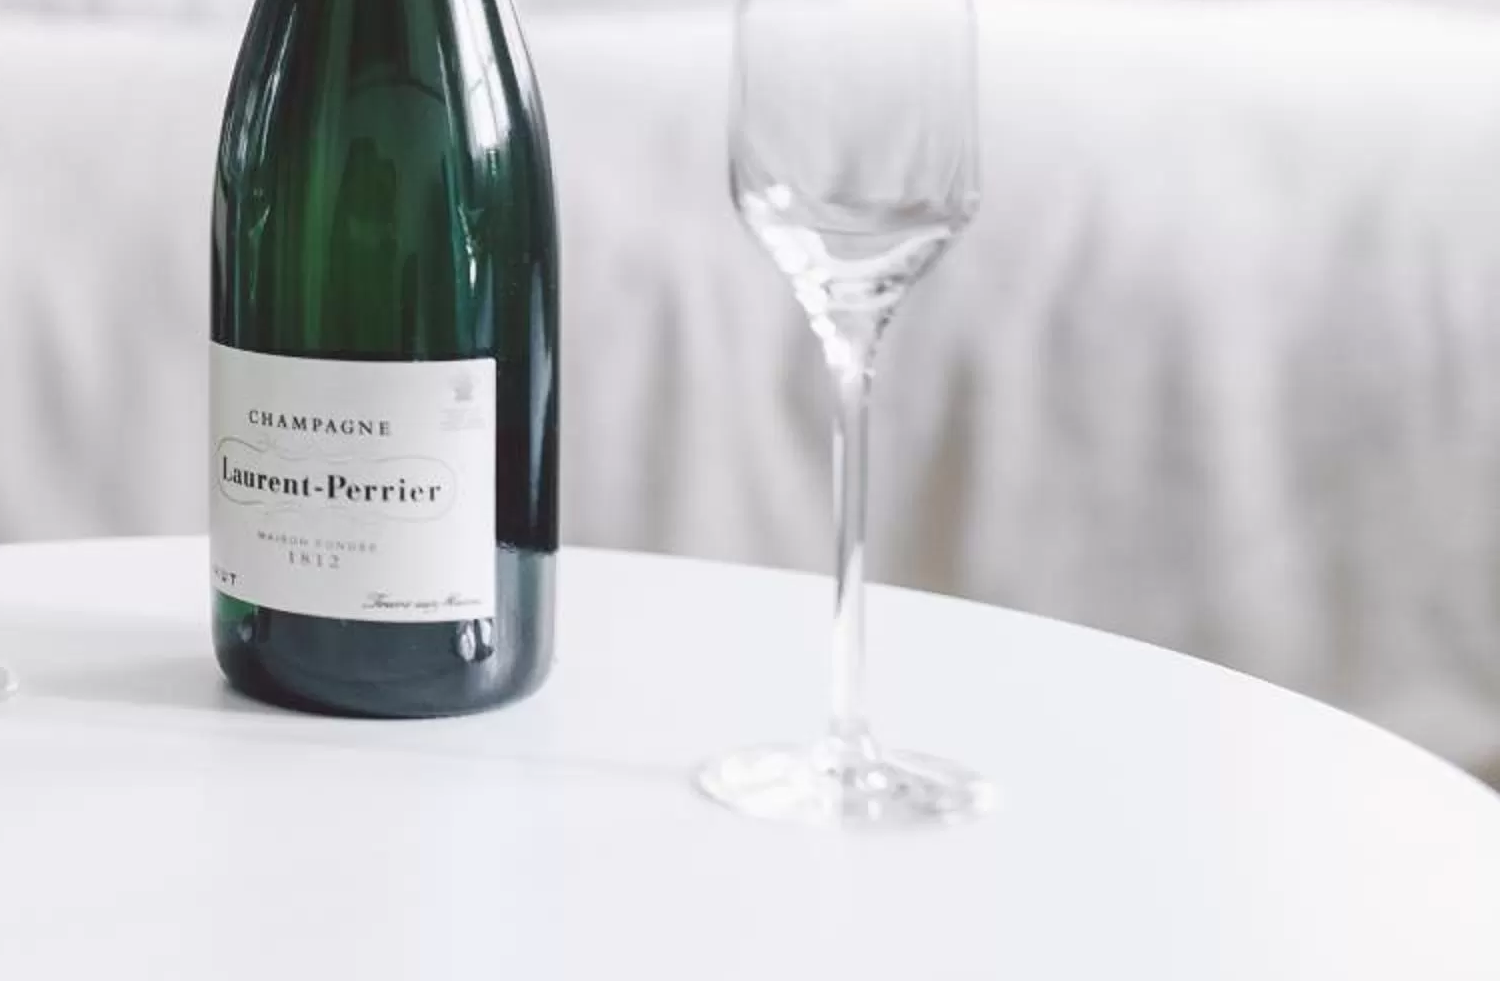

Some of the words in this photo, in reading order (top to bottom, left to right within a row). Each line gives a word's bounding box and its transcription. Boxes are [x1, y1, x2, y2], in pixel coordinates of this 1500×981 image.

[248, 408, 392, 437] CHAMPAGNE
[222, 454, 442, 503] Laurent-Perrier
[288, 550, 341, 568] 1812
